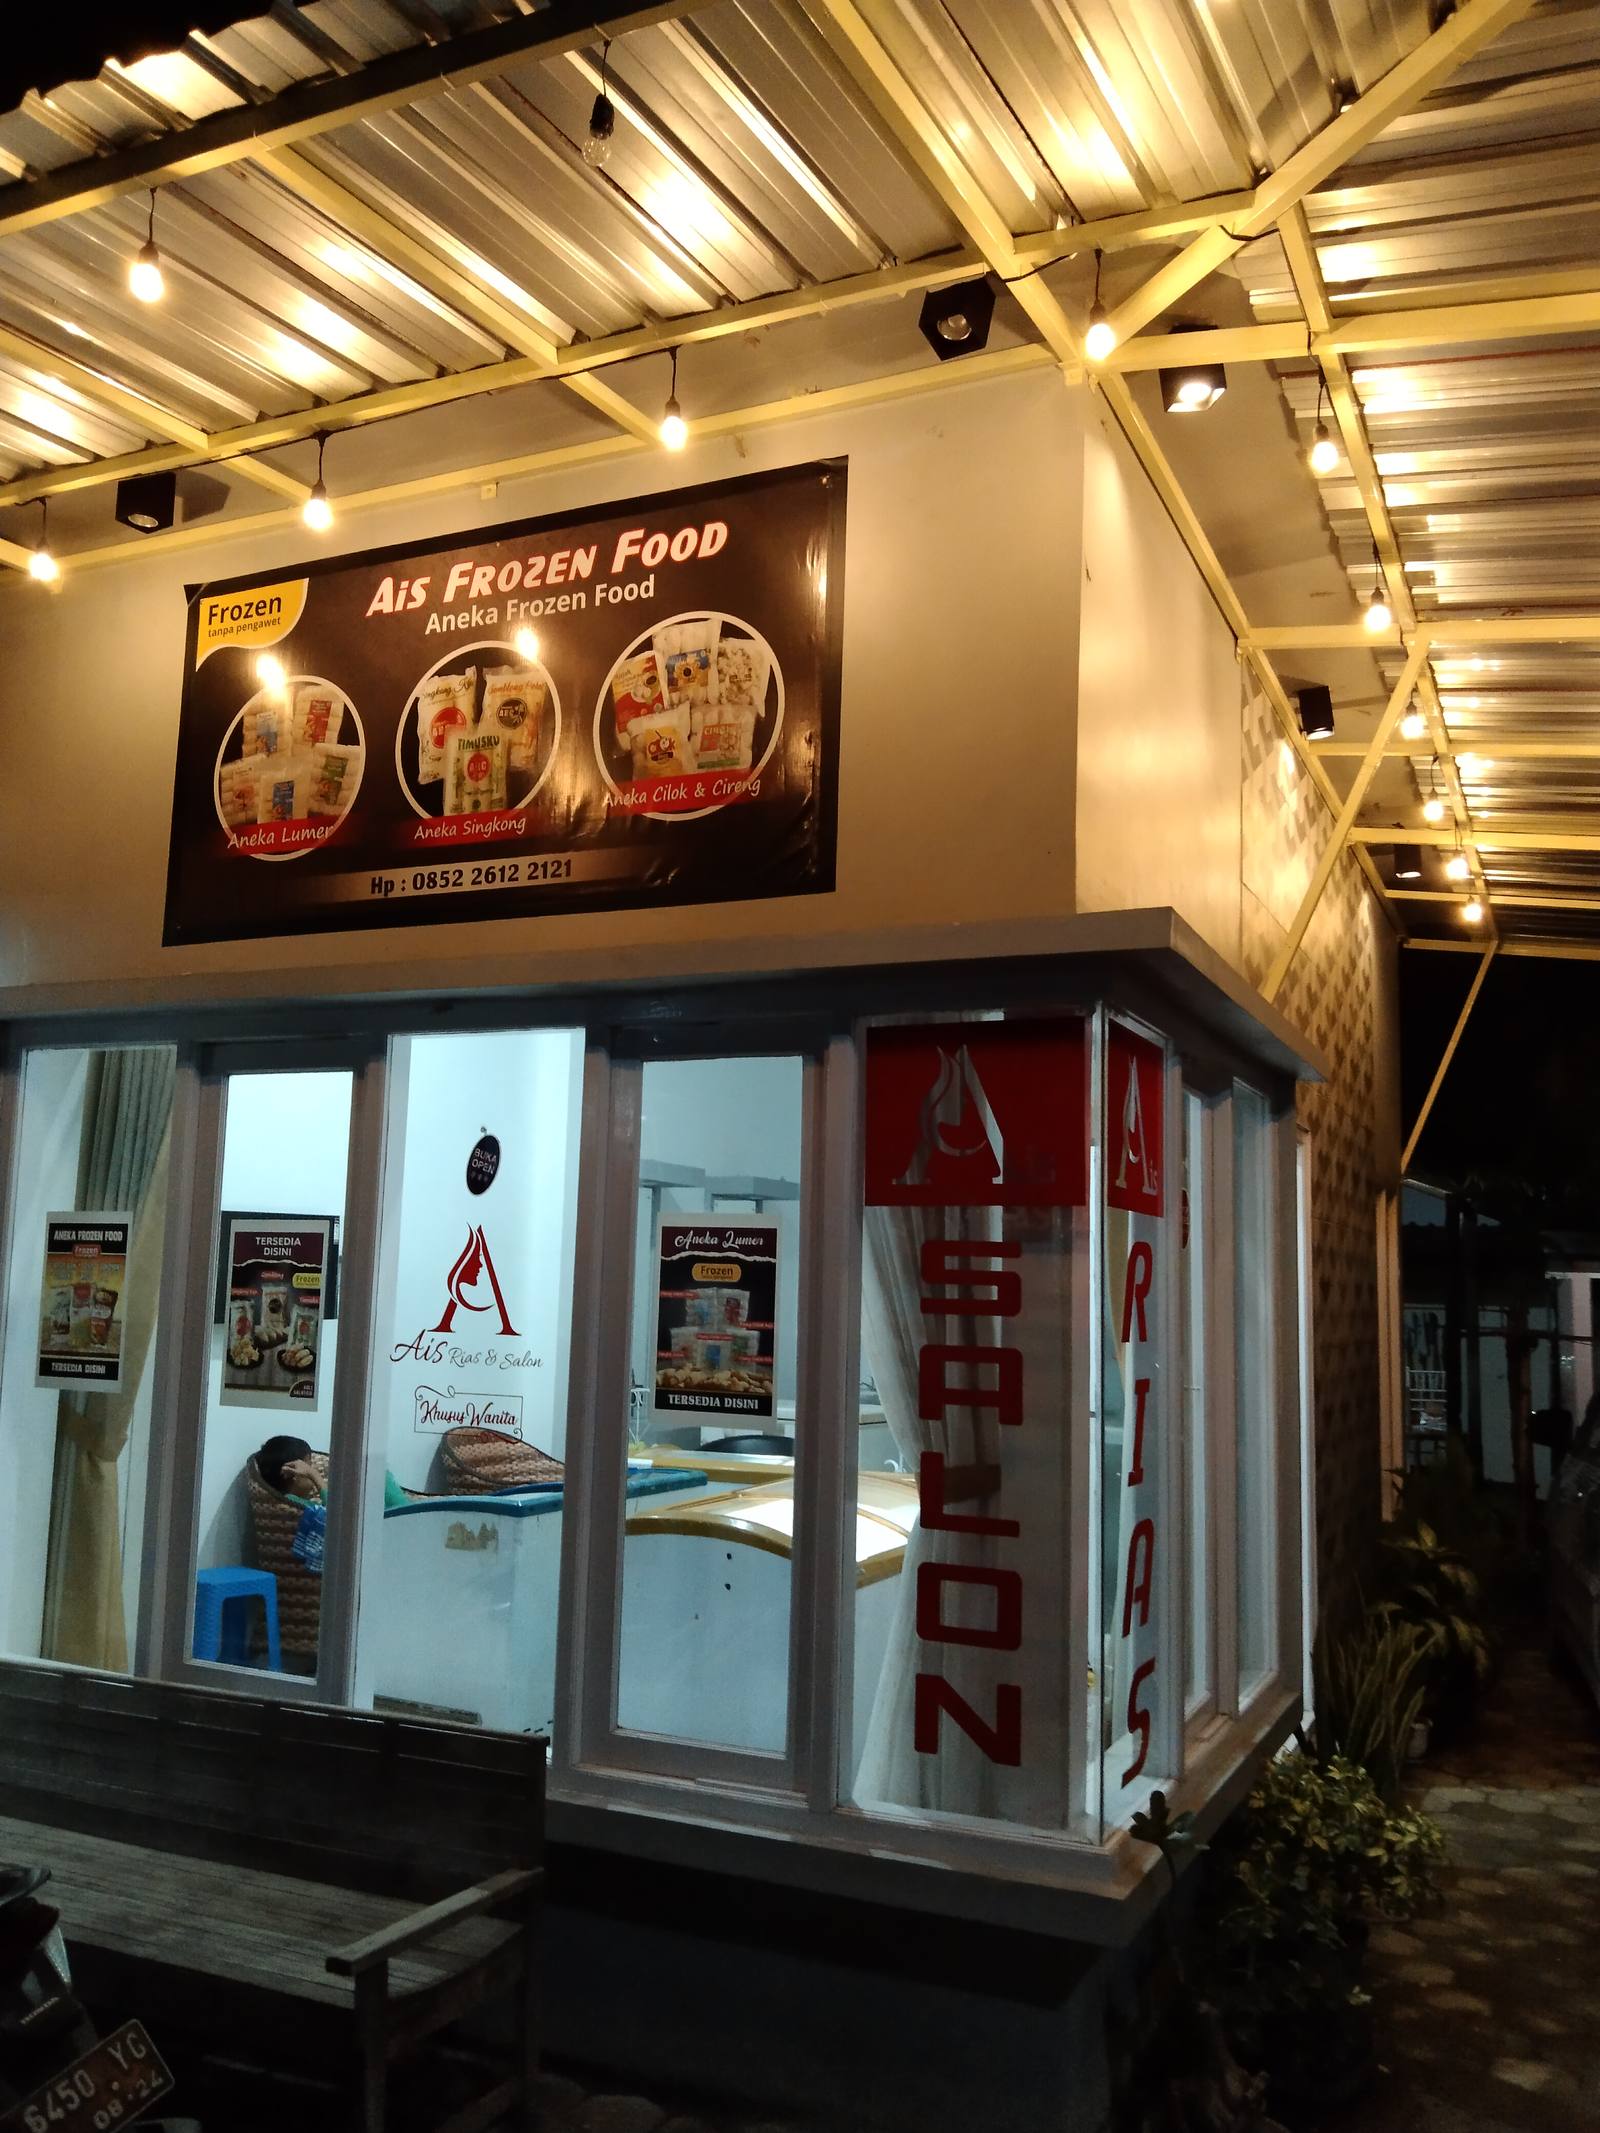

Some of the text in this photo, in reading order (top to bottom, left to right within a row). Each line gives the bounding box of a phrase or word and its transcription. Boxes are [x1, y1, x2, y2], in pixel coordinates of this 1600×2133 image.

[442, 545, 598, 604] FROZEN
[611, 521, 730, 574] FOOD
[208, 596, 282, 625] Frozen
[424, 574, 656, 635] Aneka Frozen Food
[208, 617, 281, 638] tanpa pengawet
[602, 778, 761, 808] Aneka Cilok & Cireng
[227, 824, 335, 849] Aneka Lumer
[414, 816, 526, 840] Aneka Singkong
[371, 876, 395, 896] Hp
[412, 869, 464, 890] 0852
[471, 864, 519, 886] 2612
[527, 859, 572, 880] 2121
[475, 1148, 497, 1162] BUKA
[472, 1159, 495, 1174] OPEN
[54, 1230, 123, 1241] ANEKA FROZEN FOOD
[256, 1237, 301, 1246] TERSEDIA
[674, 1229, 764, 1250] Aneka Lumer
[263, 1247, 292, 1256] DISINI
[296, 1275, 320, 1284] Frozen
[701, 1265, 733, 1276] Frozen
[389, 1328, 544, 1370] Ais Rias & Salon
[51, 1362, 106, 1374] TERSEDIA DISINI
[668, 1394, 759, 1409] TERSEDIA DISINI
[466, 1402, 518, 1426] Wanita
[914, 1239, 1025, 1767] SALON
[1121, 1241, 1156, 1790] RIAS
